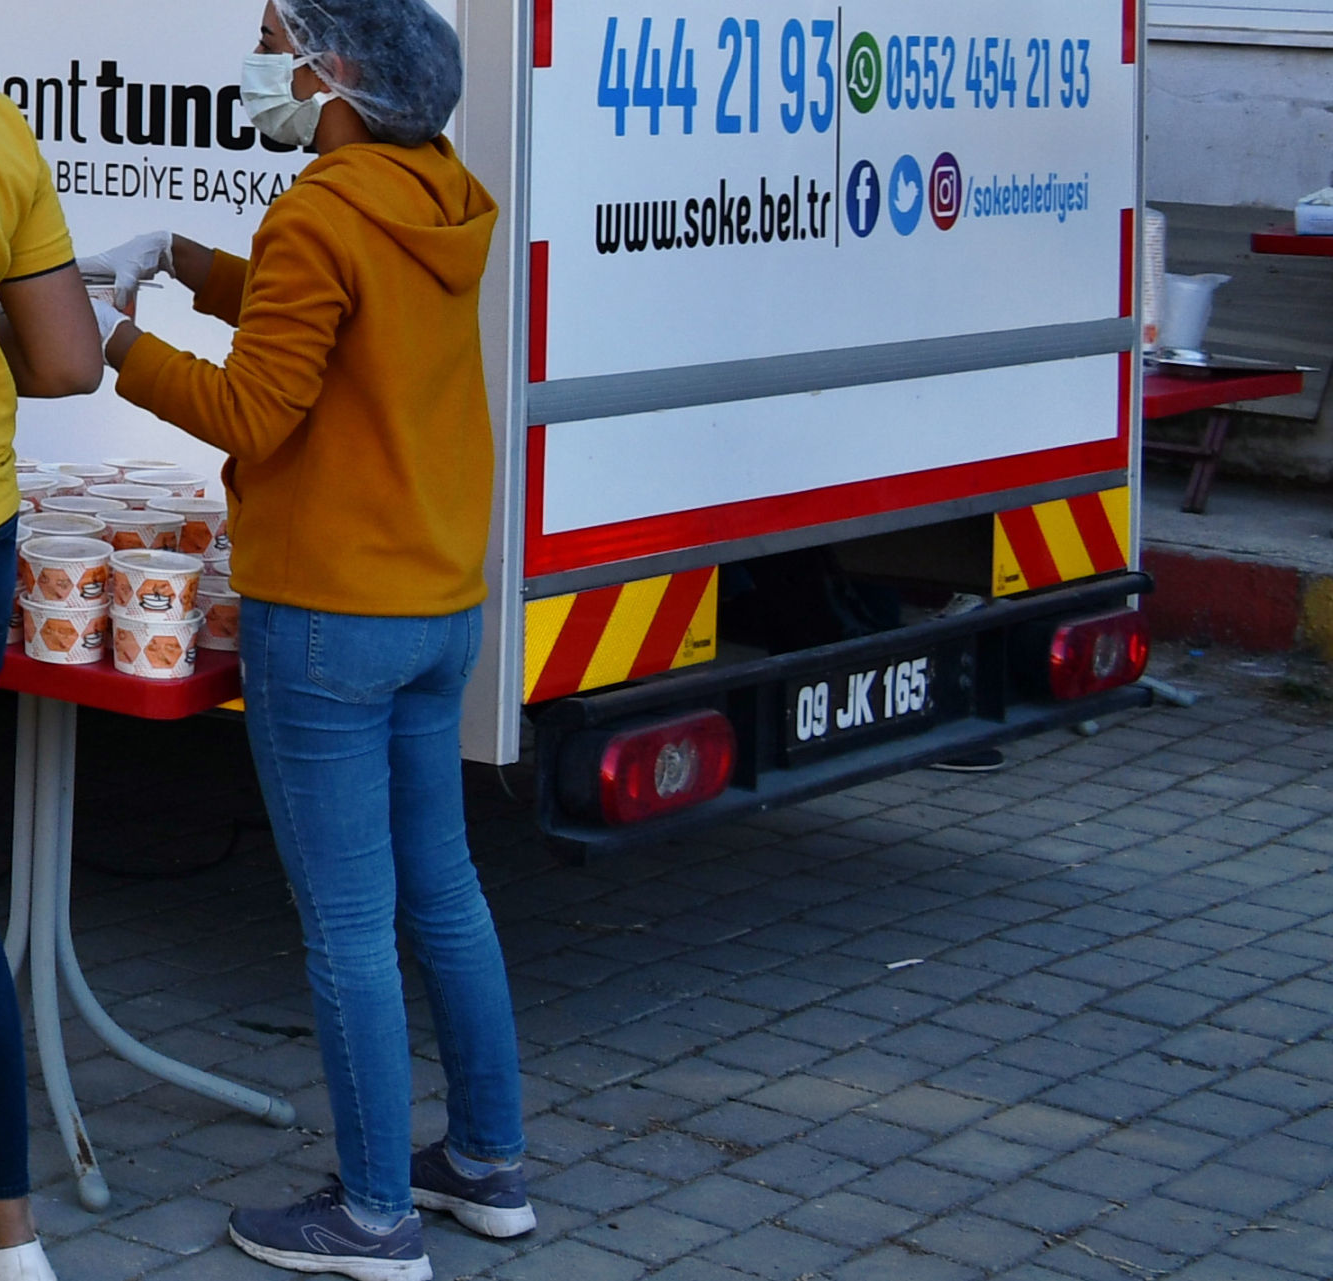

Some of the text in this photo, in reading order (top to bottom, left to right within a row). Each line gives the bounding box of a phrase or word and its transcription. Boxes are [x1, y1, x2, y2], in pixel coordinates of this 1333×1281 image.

[95, 60, 319, 153] tunc
[597, 17, 834, 136] 444 21 93
[886, 36, 1090, 109] 0552 454 21 93
[57, 156, 298, 215] BELEDİYE BAŞKA
[596, 175, 831, 255] www.soke.bel.tr
[963, 172, 1089, 223] /sokebelediyesi
[796, 657, 928, 741] 09 JK 165
